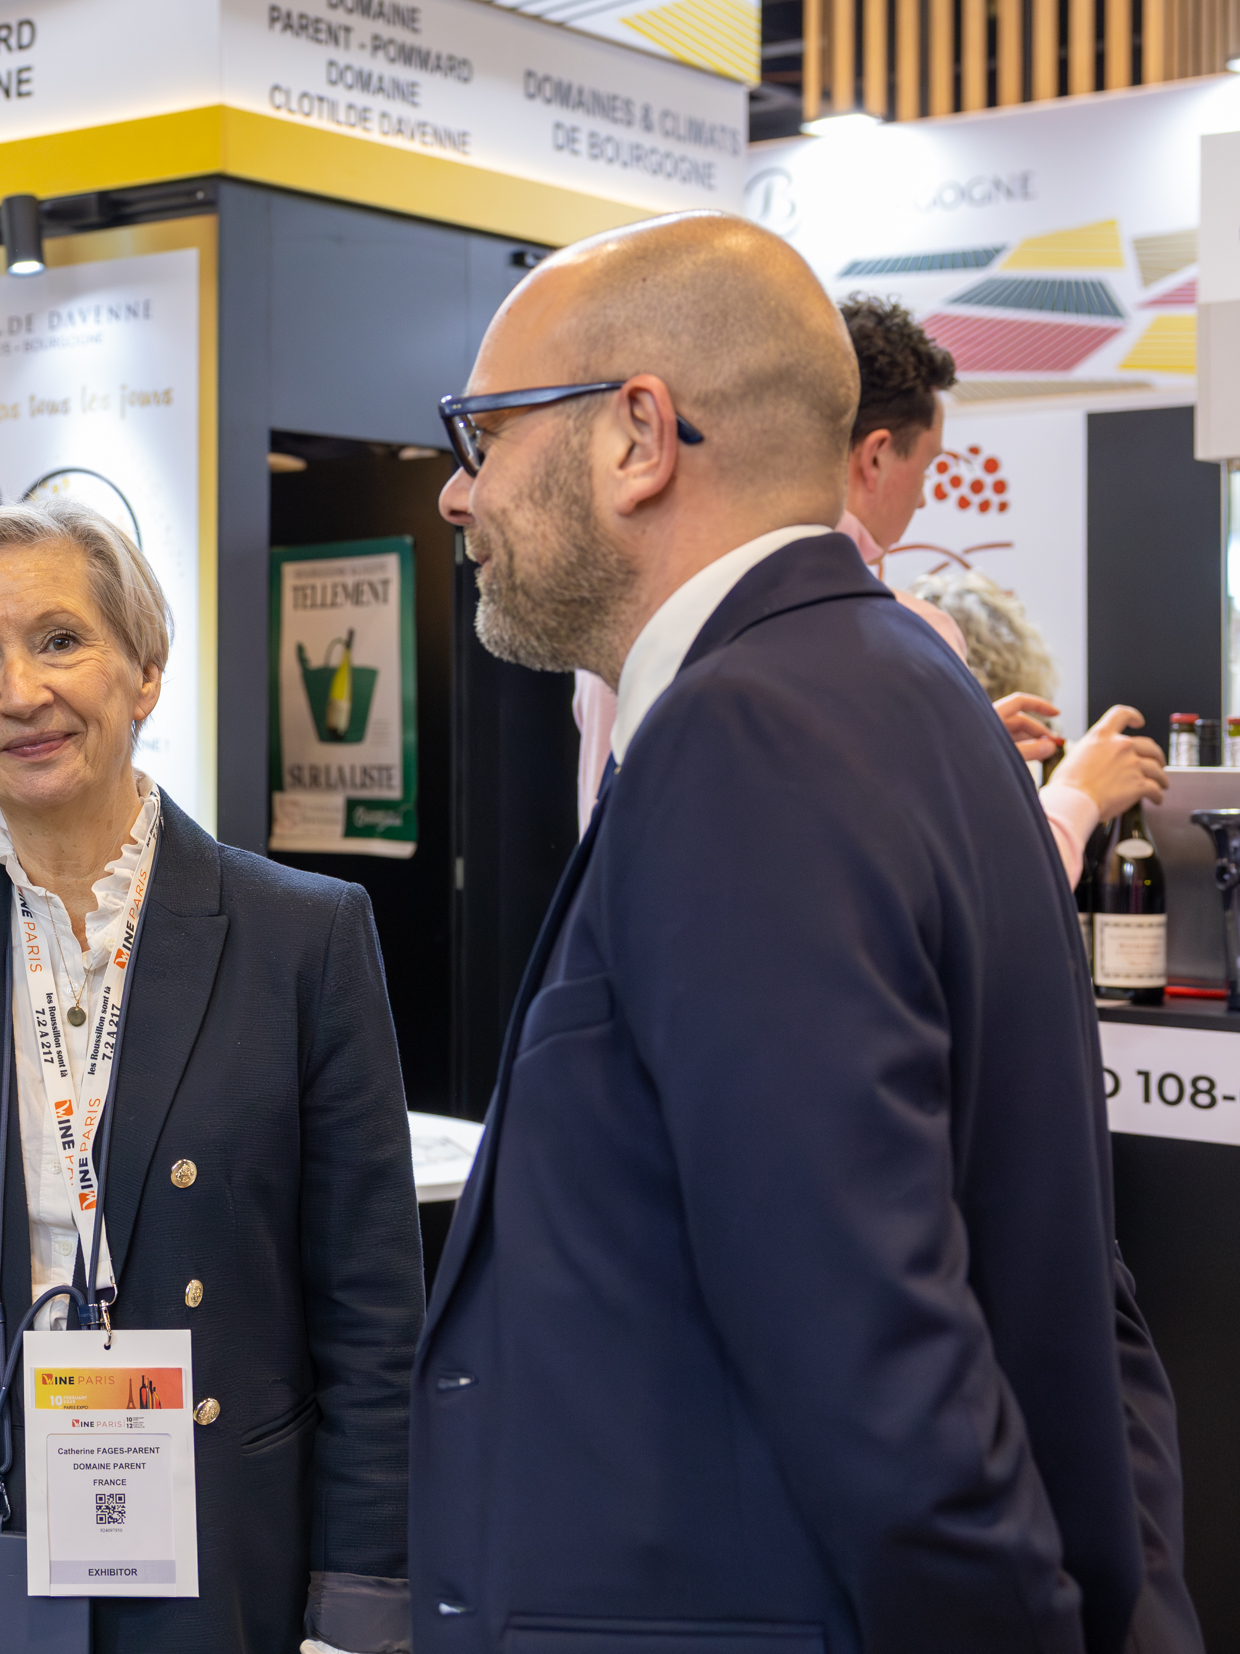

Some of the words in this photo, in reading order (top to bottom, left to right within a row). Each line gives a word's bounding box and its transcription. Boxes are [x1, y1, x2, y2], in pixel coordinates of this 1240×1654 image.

[268, 4, 354, 50] PARENT
[371, 33, 474, 84] POMMARD
[326, 59, 422, 109] DOMAINE
[269, 83, 374, 133] CLOTILDE
[378, 110, 473, 156] DAVENNE
[524, 68, 635, 128] DOMAINES
[641, 103, 654, 133] &
[660, 108, 741, 157] CLIMATS
[553, 121, 582, 157] DE
[588, 129, 717, 191] BOURGOGNE
[48, 298, 153, 332] DAVENNE
[113, 920, 136, 970] WINE
[129, 868, 147, 920] PARIS
[23, 921, 43, 972] PARIS
[46, 992, 54, 1004] les
[101, 995, 109, 1014] sont
[35, 1008, 47, 1027] 7.2
[109, 1003, 121, 1027] 217
[39, 1030, 49, 1038] A
[48, 1006, 62, 1048] Roussillon
[107, 1031, 117, 1040] A
[90, 1016, 106, 1060] Roussillon
[41, 1041, 54, 1064] 217
[56, 1049, 66, 1068] sont
[102, 1041, 115, 1061] 7.2
[60, 1069, 69, 1078] là
[88, 1062, 97, 1075] les
[54, 1099, 75, 1151] WINE
[79, 1098, 101, 1152] PARIS
[78, 1157, 97, 1211] WINE
[42, 1373, 75, 1385] WINE
[78, 1375, 115, 1385] PARIS
[50, 1395, 63, 1406] 10
[72, 1419, 95, 1427] WINE
[96, 1420, 123, 1428] PARIS
[57, 1447, 95, 1455] Catherine
[96, 1447, 160, 1455] FAGES-PARENT
[113, 1462, 146, 1470] PARENT
[88, 1568, 138, 1577] EXHIBITOR
